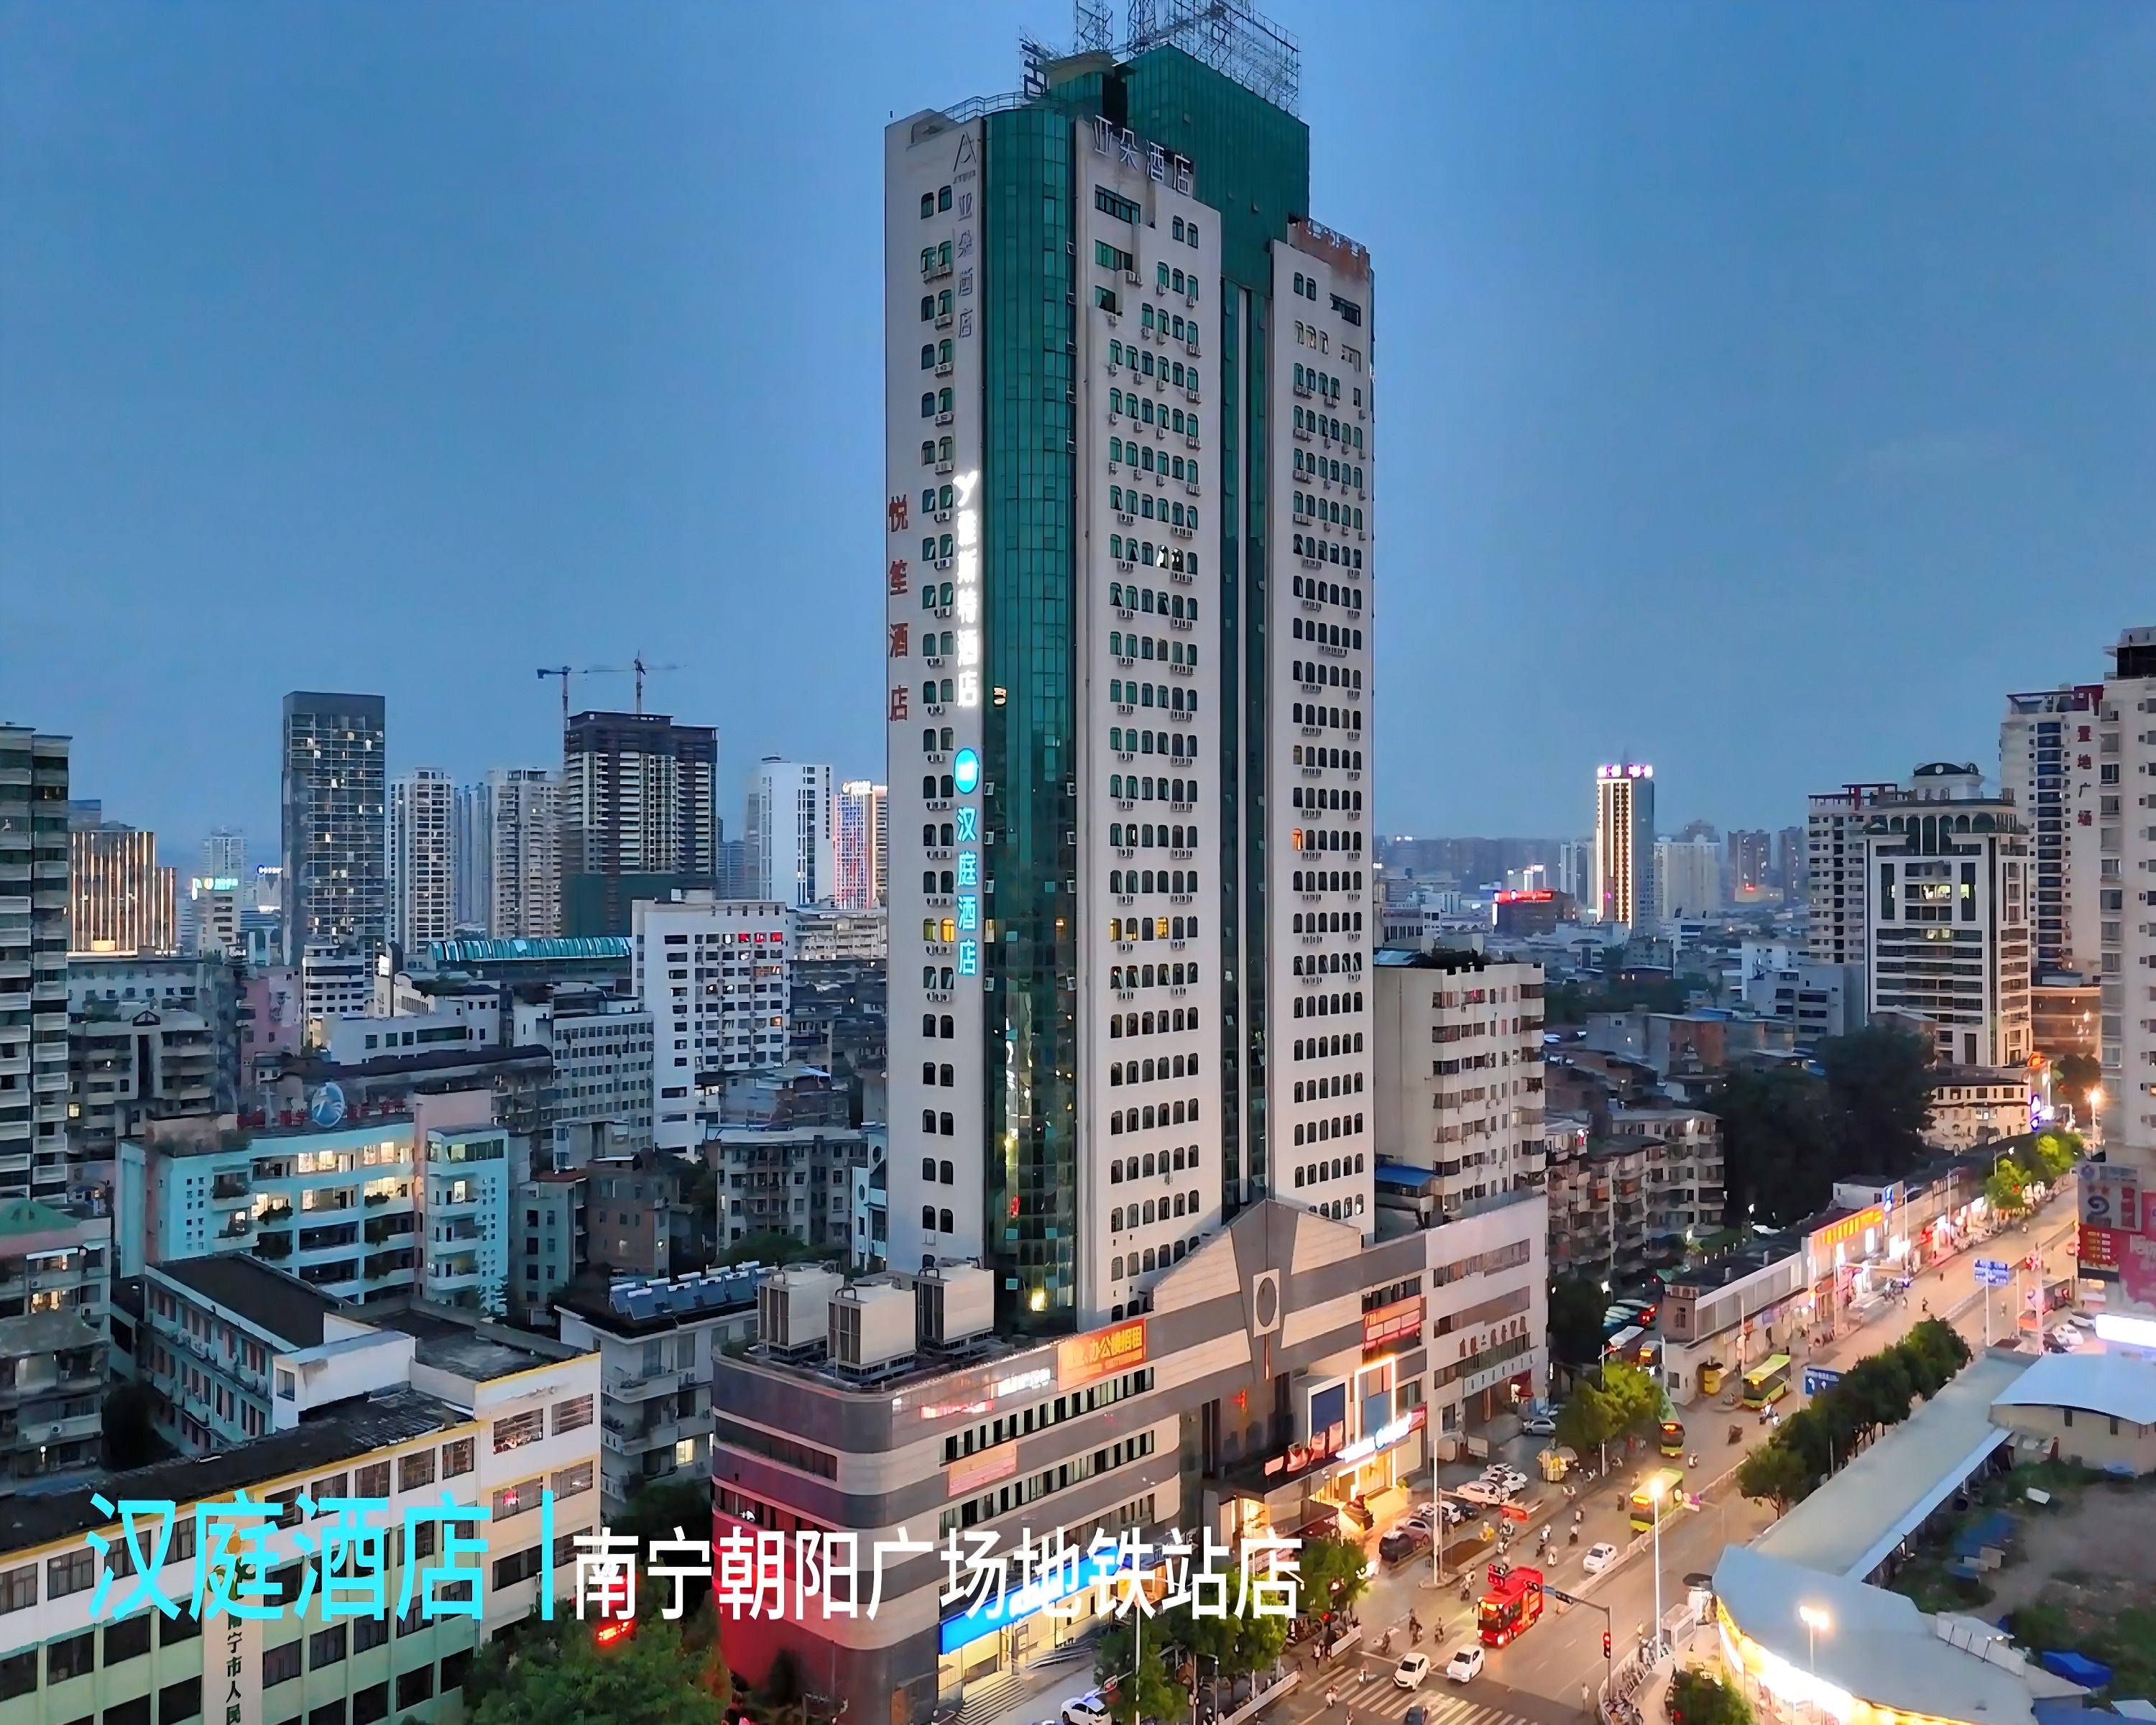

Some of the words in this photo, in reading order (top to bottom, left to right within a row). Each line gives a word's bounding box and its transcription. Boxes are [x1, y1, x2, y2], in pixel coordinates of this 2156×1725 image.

[1091, 114, 1192, 196] 亚朵酒店
[957, 191, 974, 339] 亚朵酒店
[956, 806, 978, 976] 汉庭酒店
